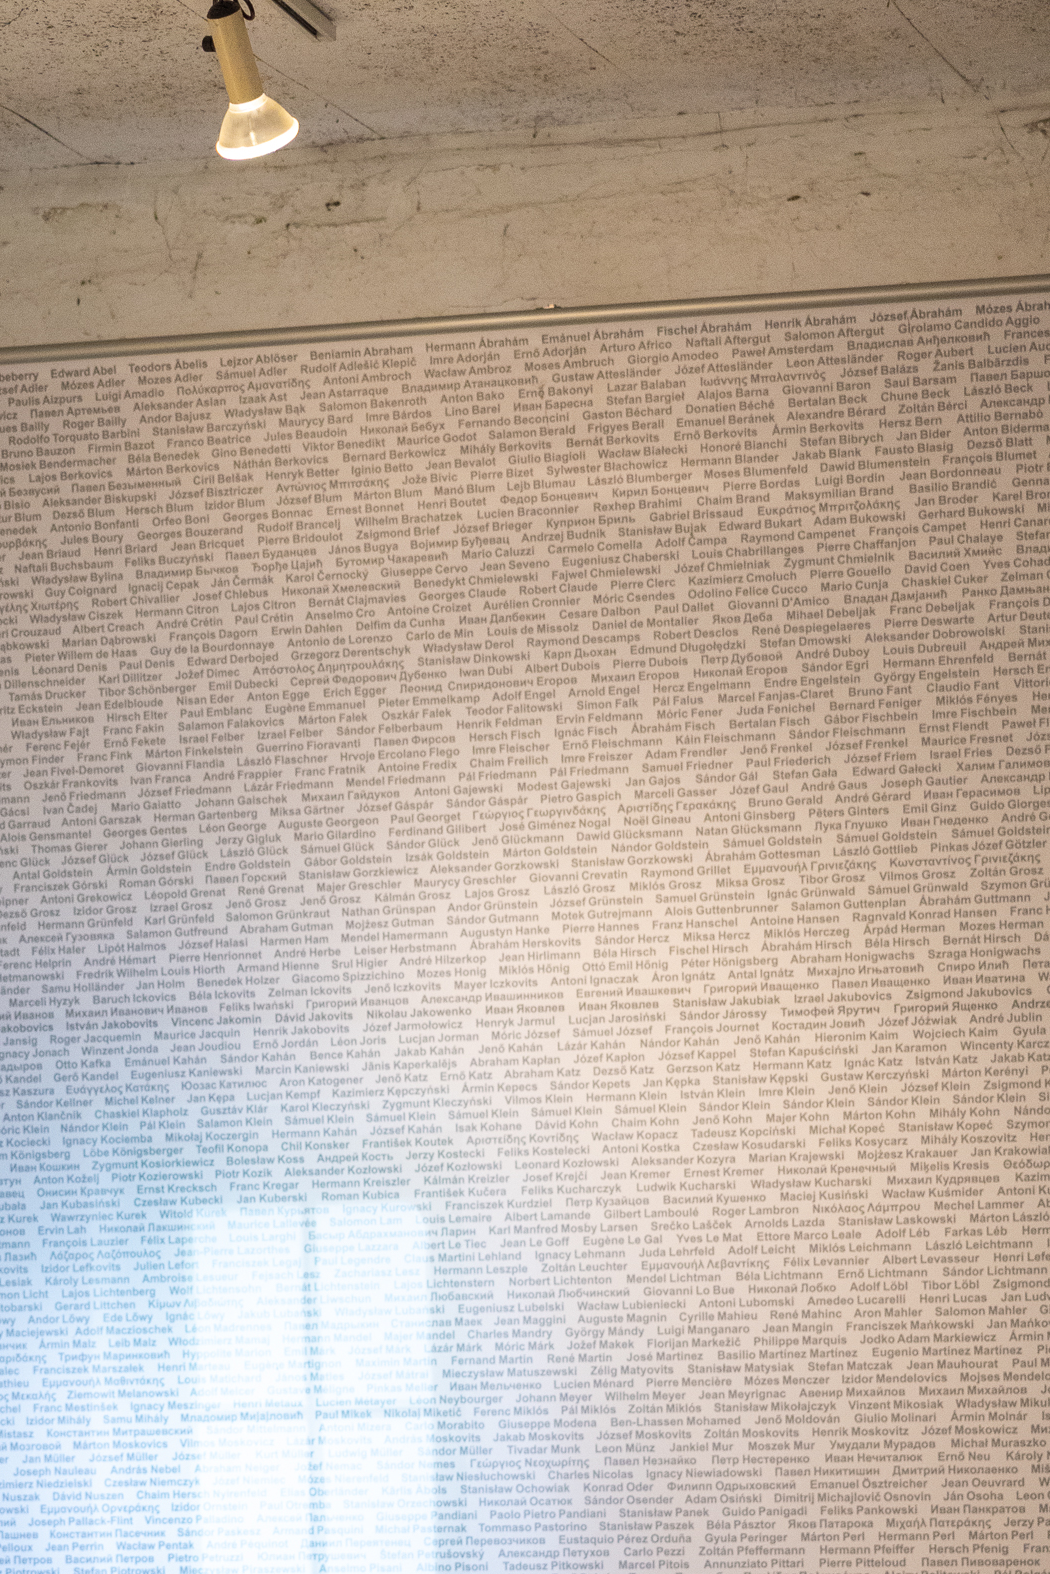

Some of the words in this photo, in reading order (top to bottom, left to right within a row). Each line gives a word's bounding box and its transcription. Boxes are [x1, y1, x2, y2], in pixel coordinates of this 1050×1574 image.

[784, 330, 834, 342] Salomon
[387, 605, 430, 617] Antoine
[432, 603, 471, 614] Croizet
[291, 650, 340, 663] Grzegorz
[824, 713, 859, 726] Gábor
[862, 710, 918, 723] Fischbein
[38, 919, 85, 930] Hermann
[87, 917, 133, 928] Grünfeld
[665, 1023, 714, 1037] François
[716, 1022, 759, 1033] Journet
[753, 1060, 804, 1071] Hermann
[807, 1059, 832, 1069] Katz
[854, 1308, 884, 1318] Aron
[885, 1307, 923, 1318] Mahler
[604, 1456, 640, 1466] Павел
[642, 1454, 696, 1466] Незнайко
[548, 1469, 590, 1480] Charles
[593, 1468, 634, 1480] Nicolas
